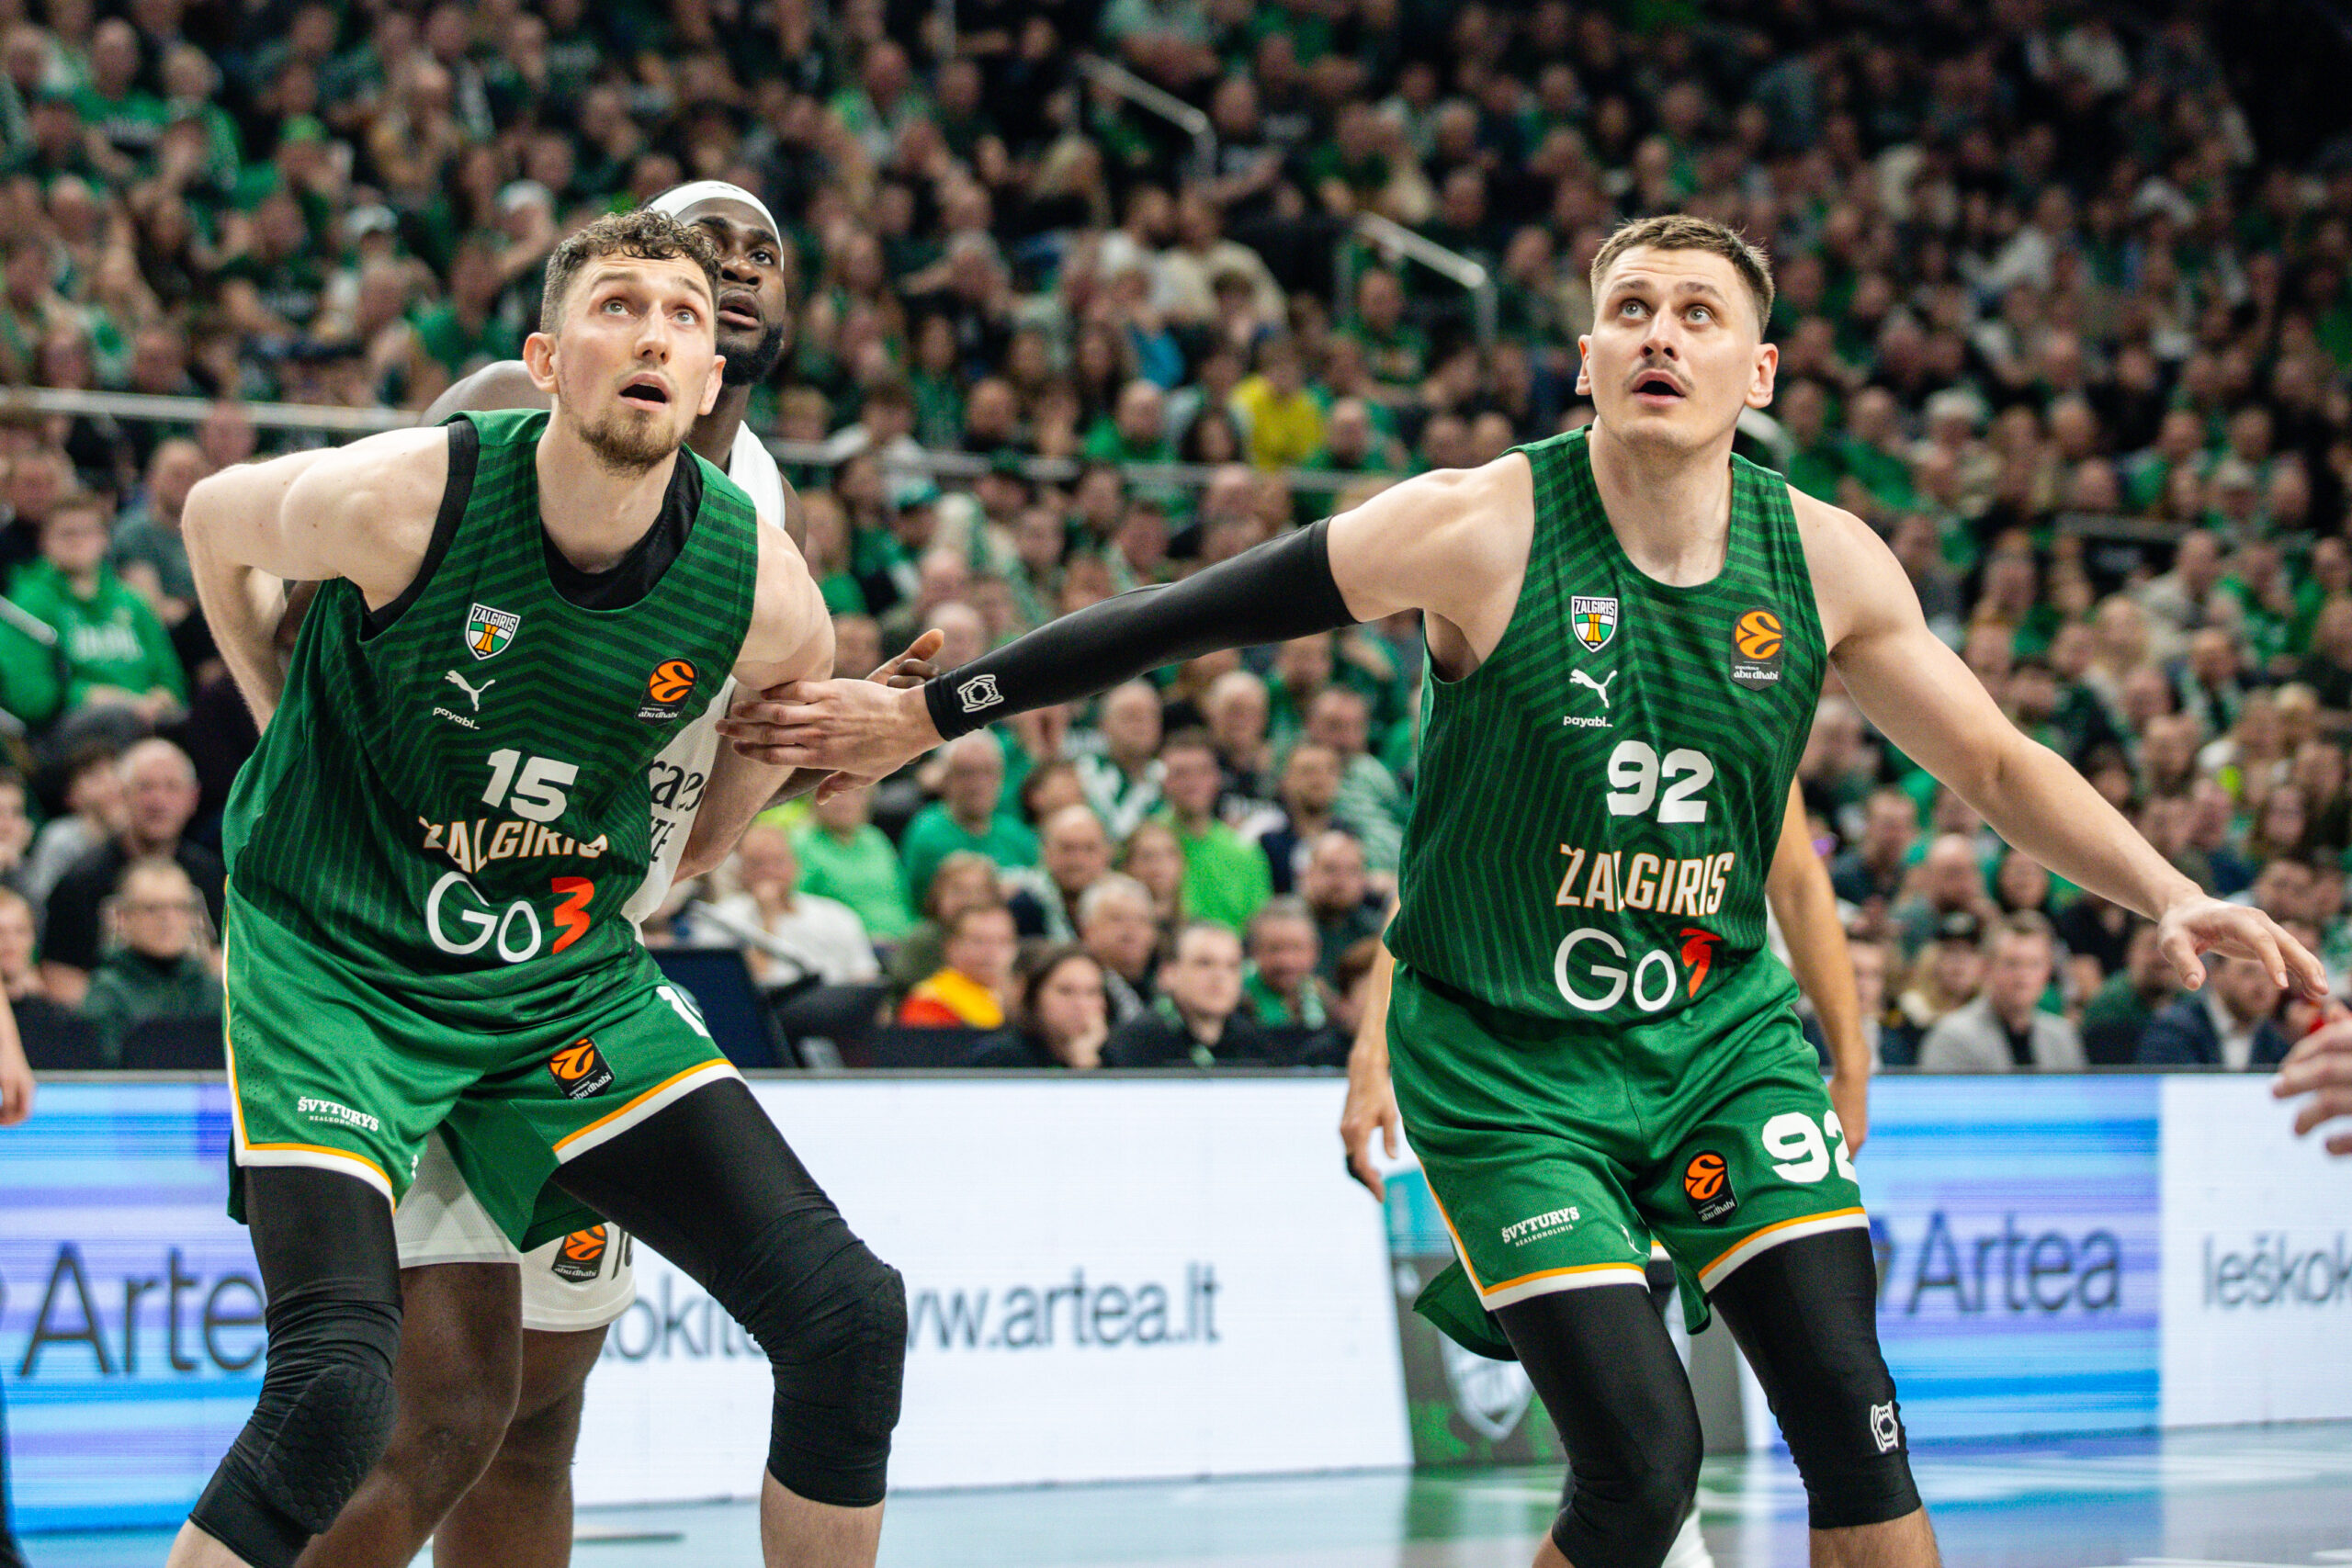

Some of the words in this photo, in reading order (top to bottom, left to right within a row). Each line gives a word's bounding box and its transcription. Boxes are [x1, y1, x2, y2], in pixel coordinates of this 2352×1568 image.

[1734, 671, 1751, 679] abu
[1753, 671, 1779, 680] dhabi
[481, 748, 580, 823] 15
[1606, 739, 1715, 824] 92
[655, 982, 712, 1039] 1
[297, 1096, 379, 1132] ŠVYTURYS
[1761, 1109, 1860, 1185] 92
[1501, 1206, 1580, 1244] ŠVYTURYS
[1905, 1212, 2120, 1314] Artea
[20, 1243, 267, 1375] Arte
[908, 1261, 1220, 1349] w.artea.lt
